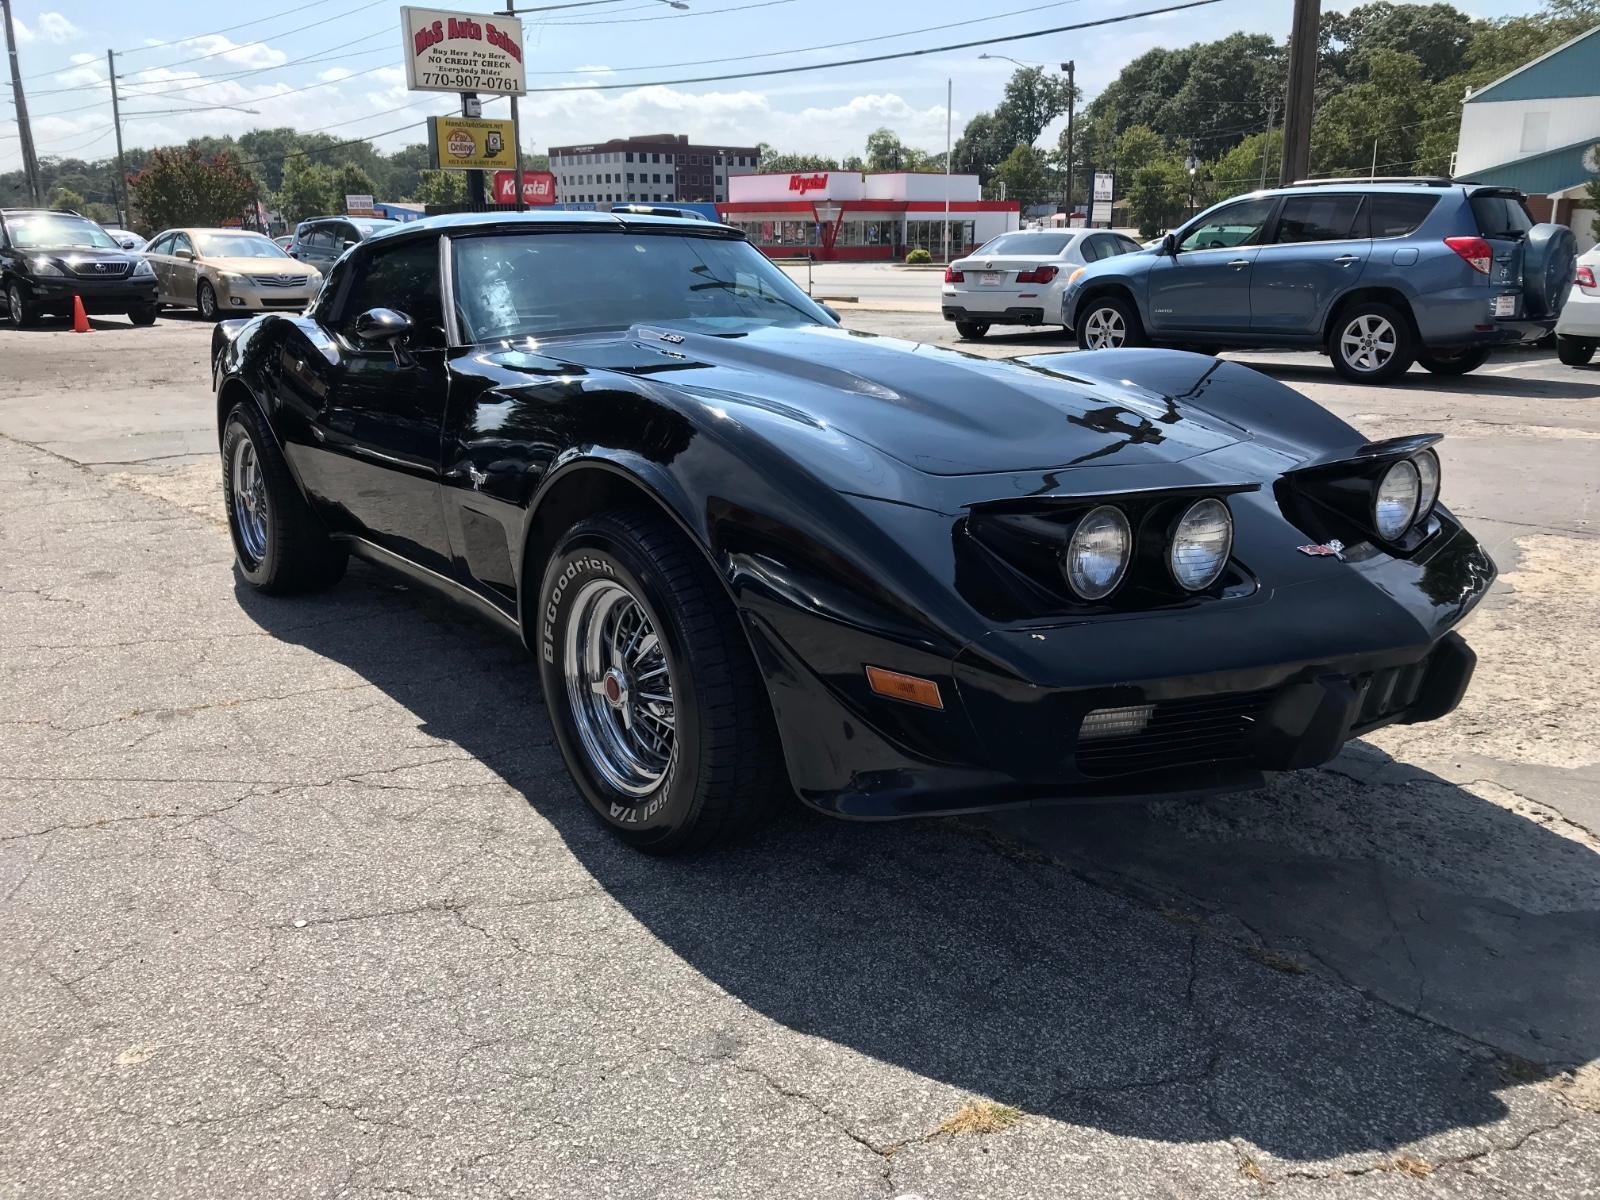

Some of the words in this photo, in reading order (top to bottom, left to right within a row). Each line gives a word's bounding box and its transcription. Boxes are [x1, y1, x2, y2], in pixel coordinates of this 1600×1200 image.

[448, 17, 482, 41] Auto
[486, 22, 522, 64] Sales
[433, 48, 448, 56] Buy
[472, 51, 487, 59] Pay
[445, 57, 478, 66] CREDIT
[481, 60, 511, 68] CHECK
[423, 72, 519, 90] 770-907-0761
[454, 134, 468, 142] Pay
[789, 174, 828, 195] Krystal
[543, 556, 616, 664] BFGoodrich
[643, 737, 680, 821] Radial
[609, 801, 638, 823] T/A
